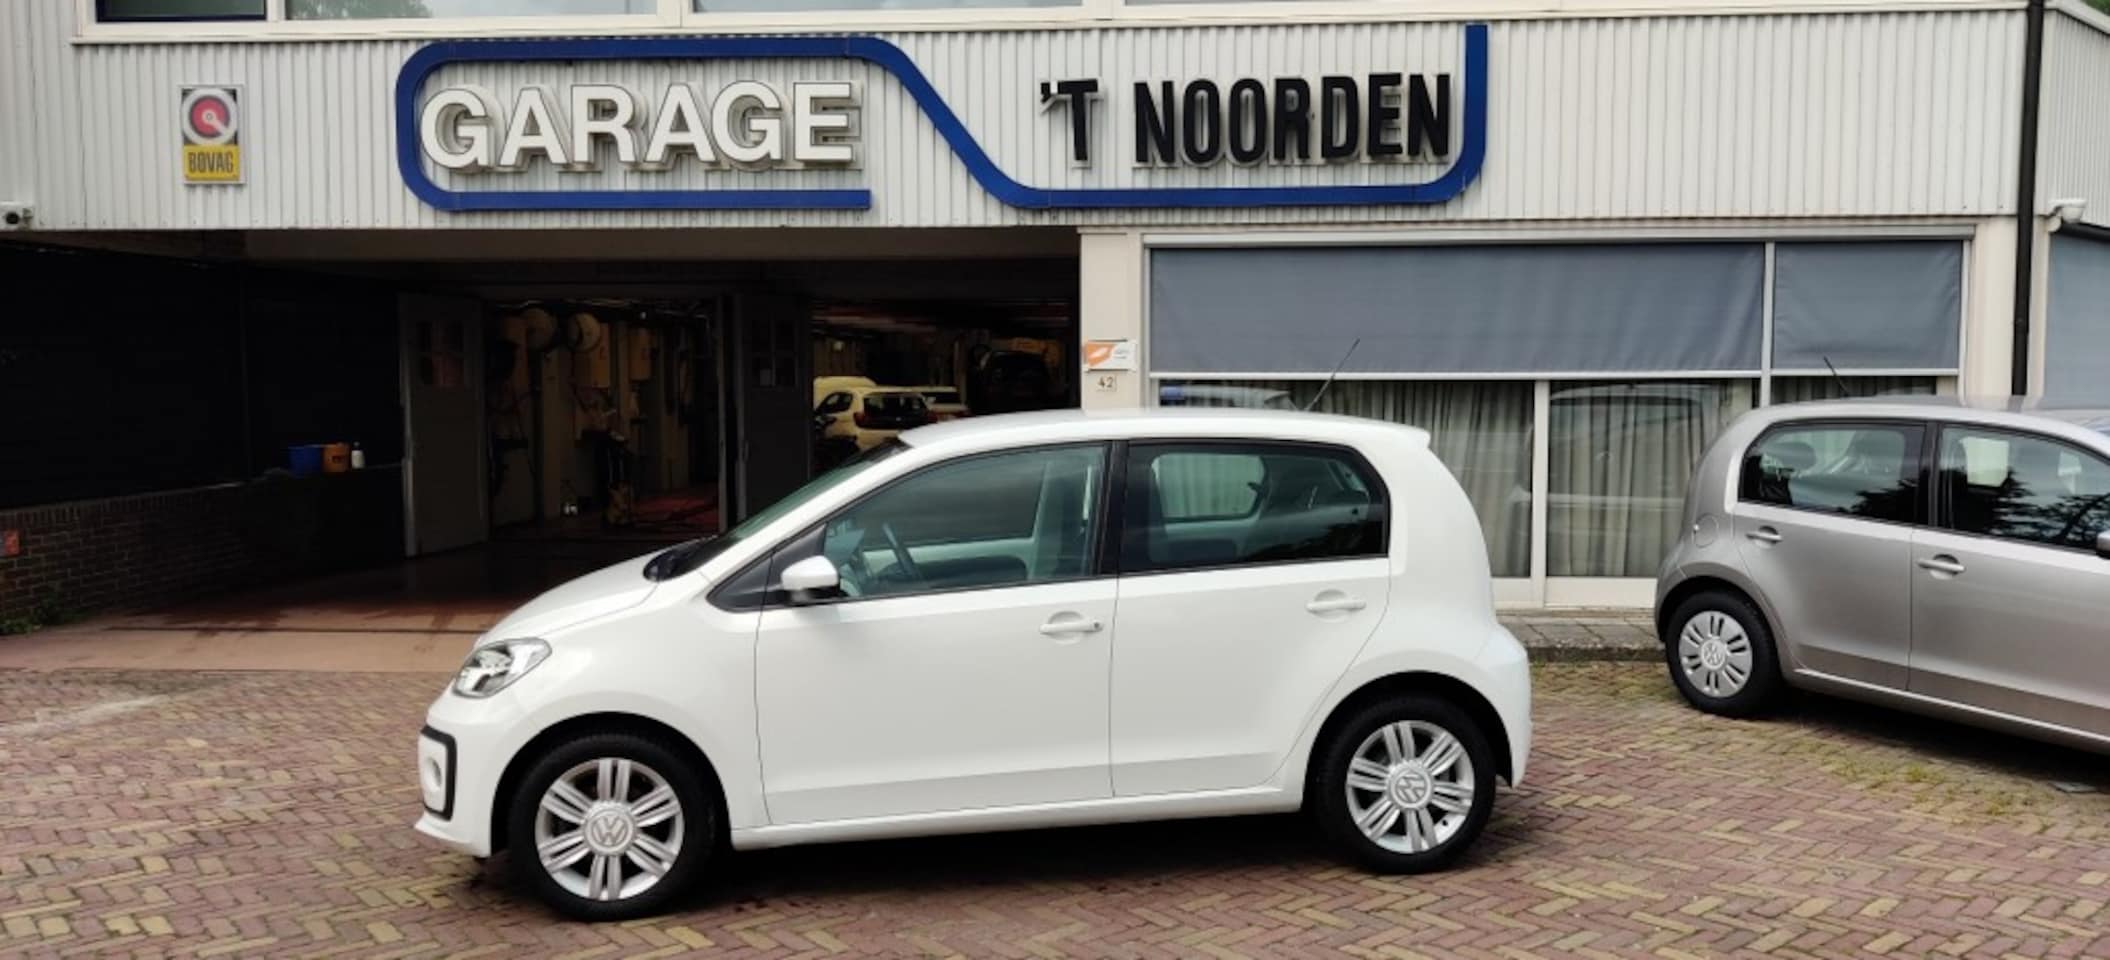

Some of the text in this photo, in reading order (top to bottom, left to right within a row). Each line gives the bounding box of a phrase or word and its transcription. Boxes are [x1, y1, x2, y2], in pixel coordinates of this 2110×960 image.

[420, 73, 1451, 170] GARAGE 'T NOORDEN
[188, 151, 234, 174] BOVAG
[1098, 376, 1114, 388] 42
